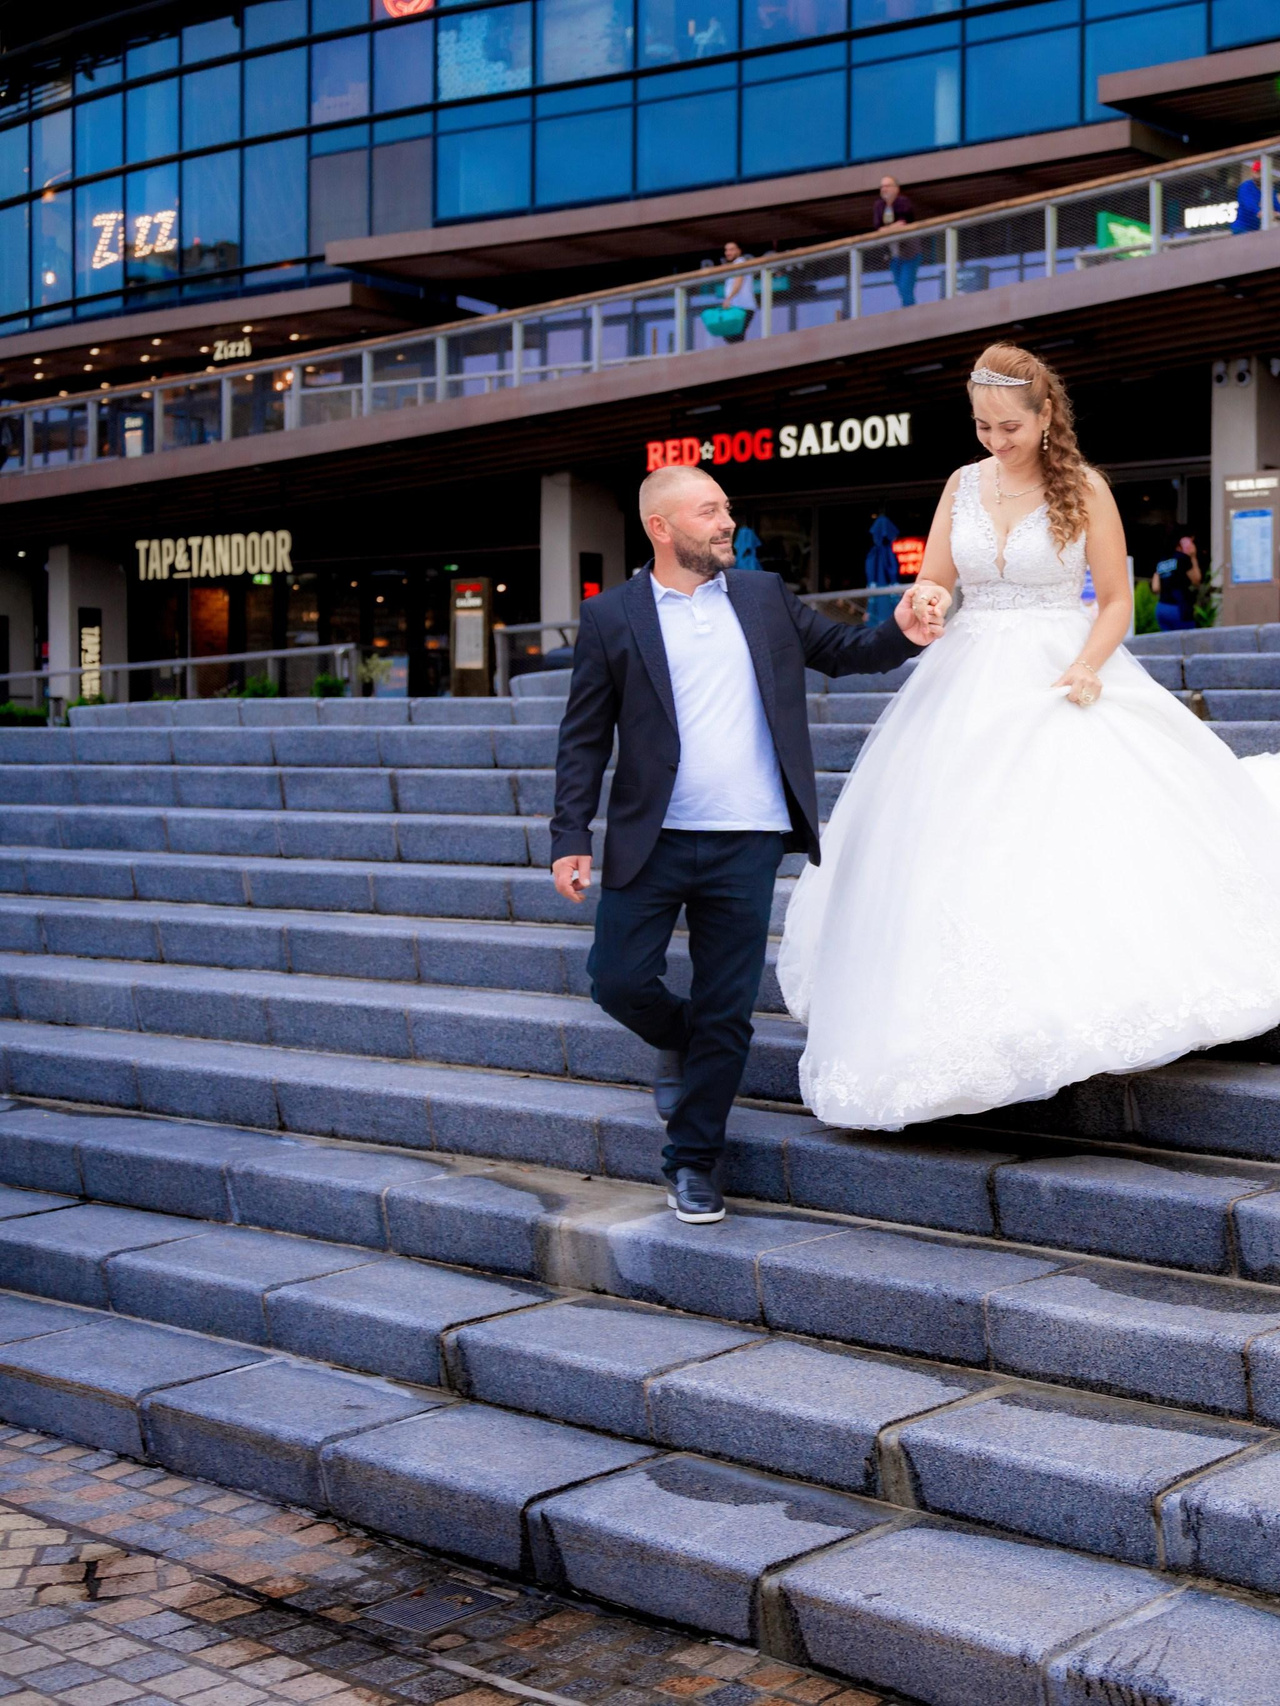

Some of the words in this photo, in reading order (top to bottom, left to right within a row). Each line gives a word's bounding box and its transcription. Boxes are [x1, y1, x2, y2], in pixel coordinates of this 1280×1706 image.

[213, 337, 252, 361] Zizzi
[646, 436, 701, 472] RED
[712, 428, 774, 465] DOG
[779, 412, 912, 459] SALOON
